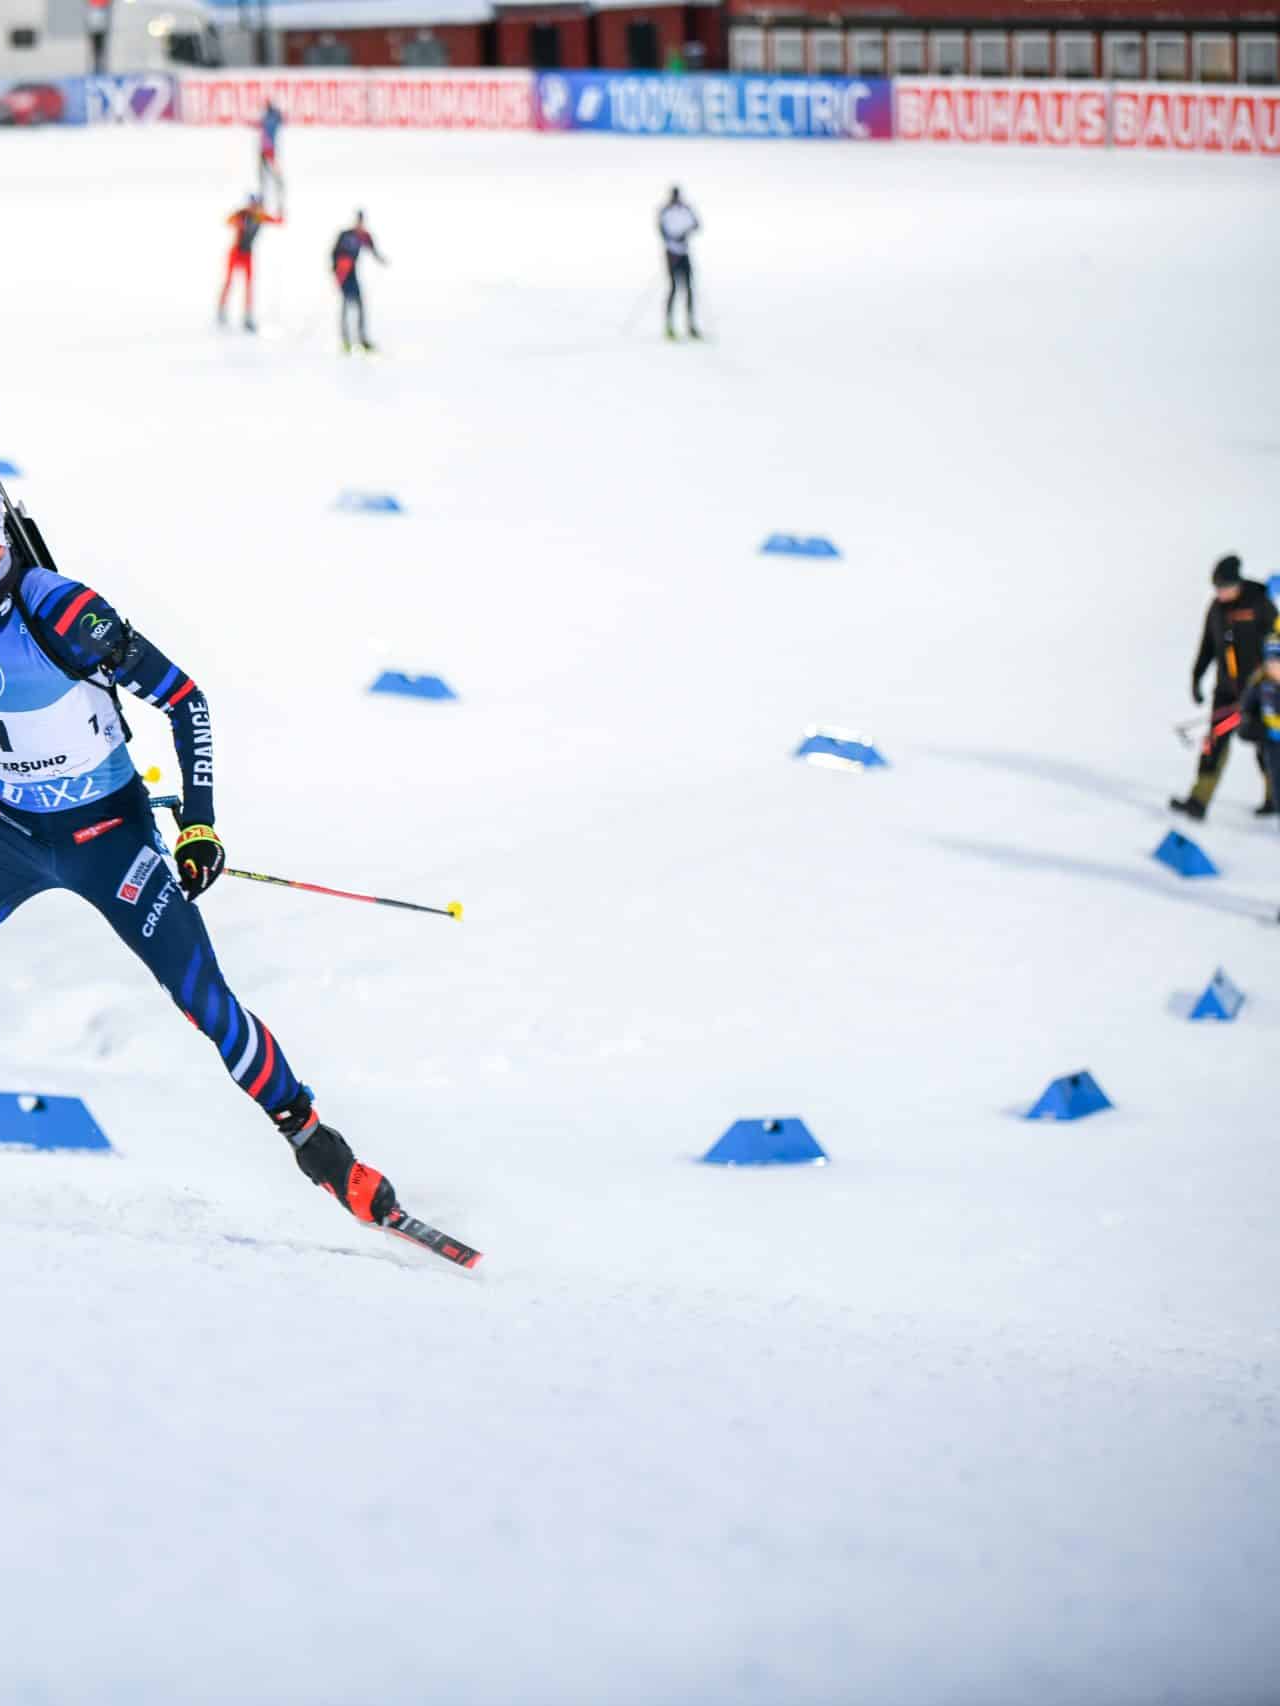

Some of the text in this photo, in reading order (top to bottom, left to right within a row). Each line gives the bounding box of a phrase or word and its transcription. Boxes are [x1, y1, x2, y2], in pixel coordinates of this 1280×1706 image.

[86, 73, 170, 124] iX2
[183, 81, 366, 127] BAUHAUS
[372, 81, 529, 128] BAUHAUS
[608, 78, 872, 137] 100% ELECTRIC
[899, 90, 1105, 143] BAUHAUS
[88, 713, 100, 736] 1
[188, 701, 214, 787] FRANCE
[36, 776, 102, 808] iX2
[142, 880, 176, 938] CRAFT
